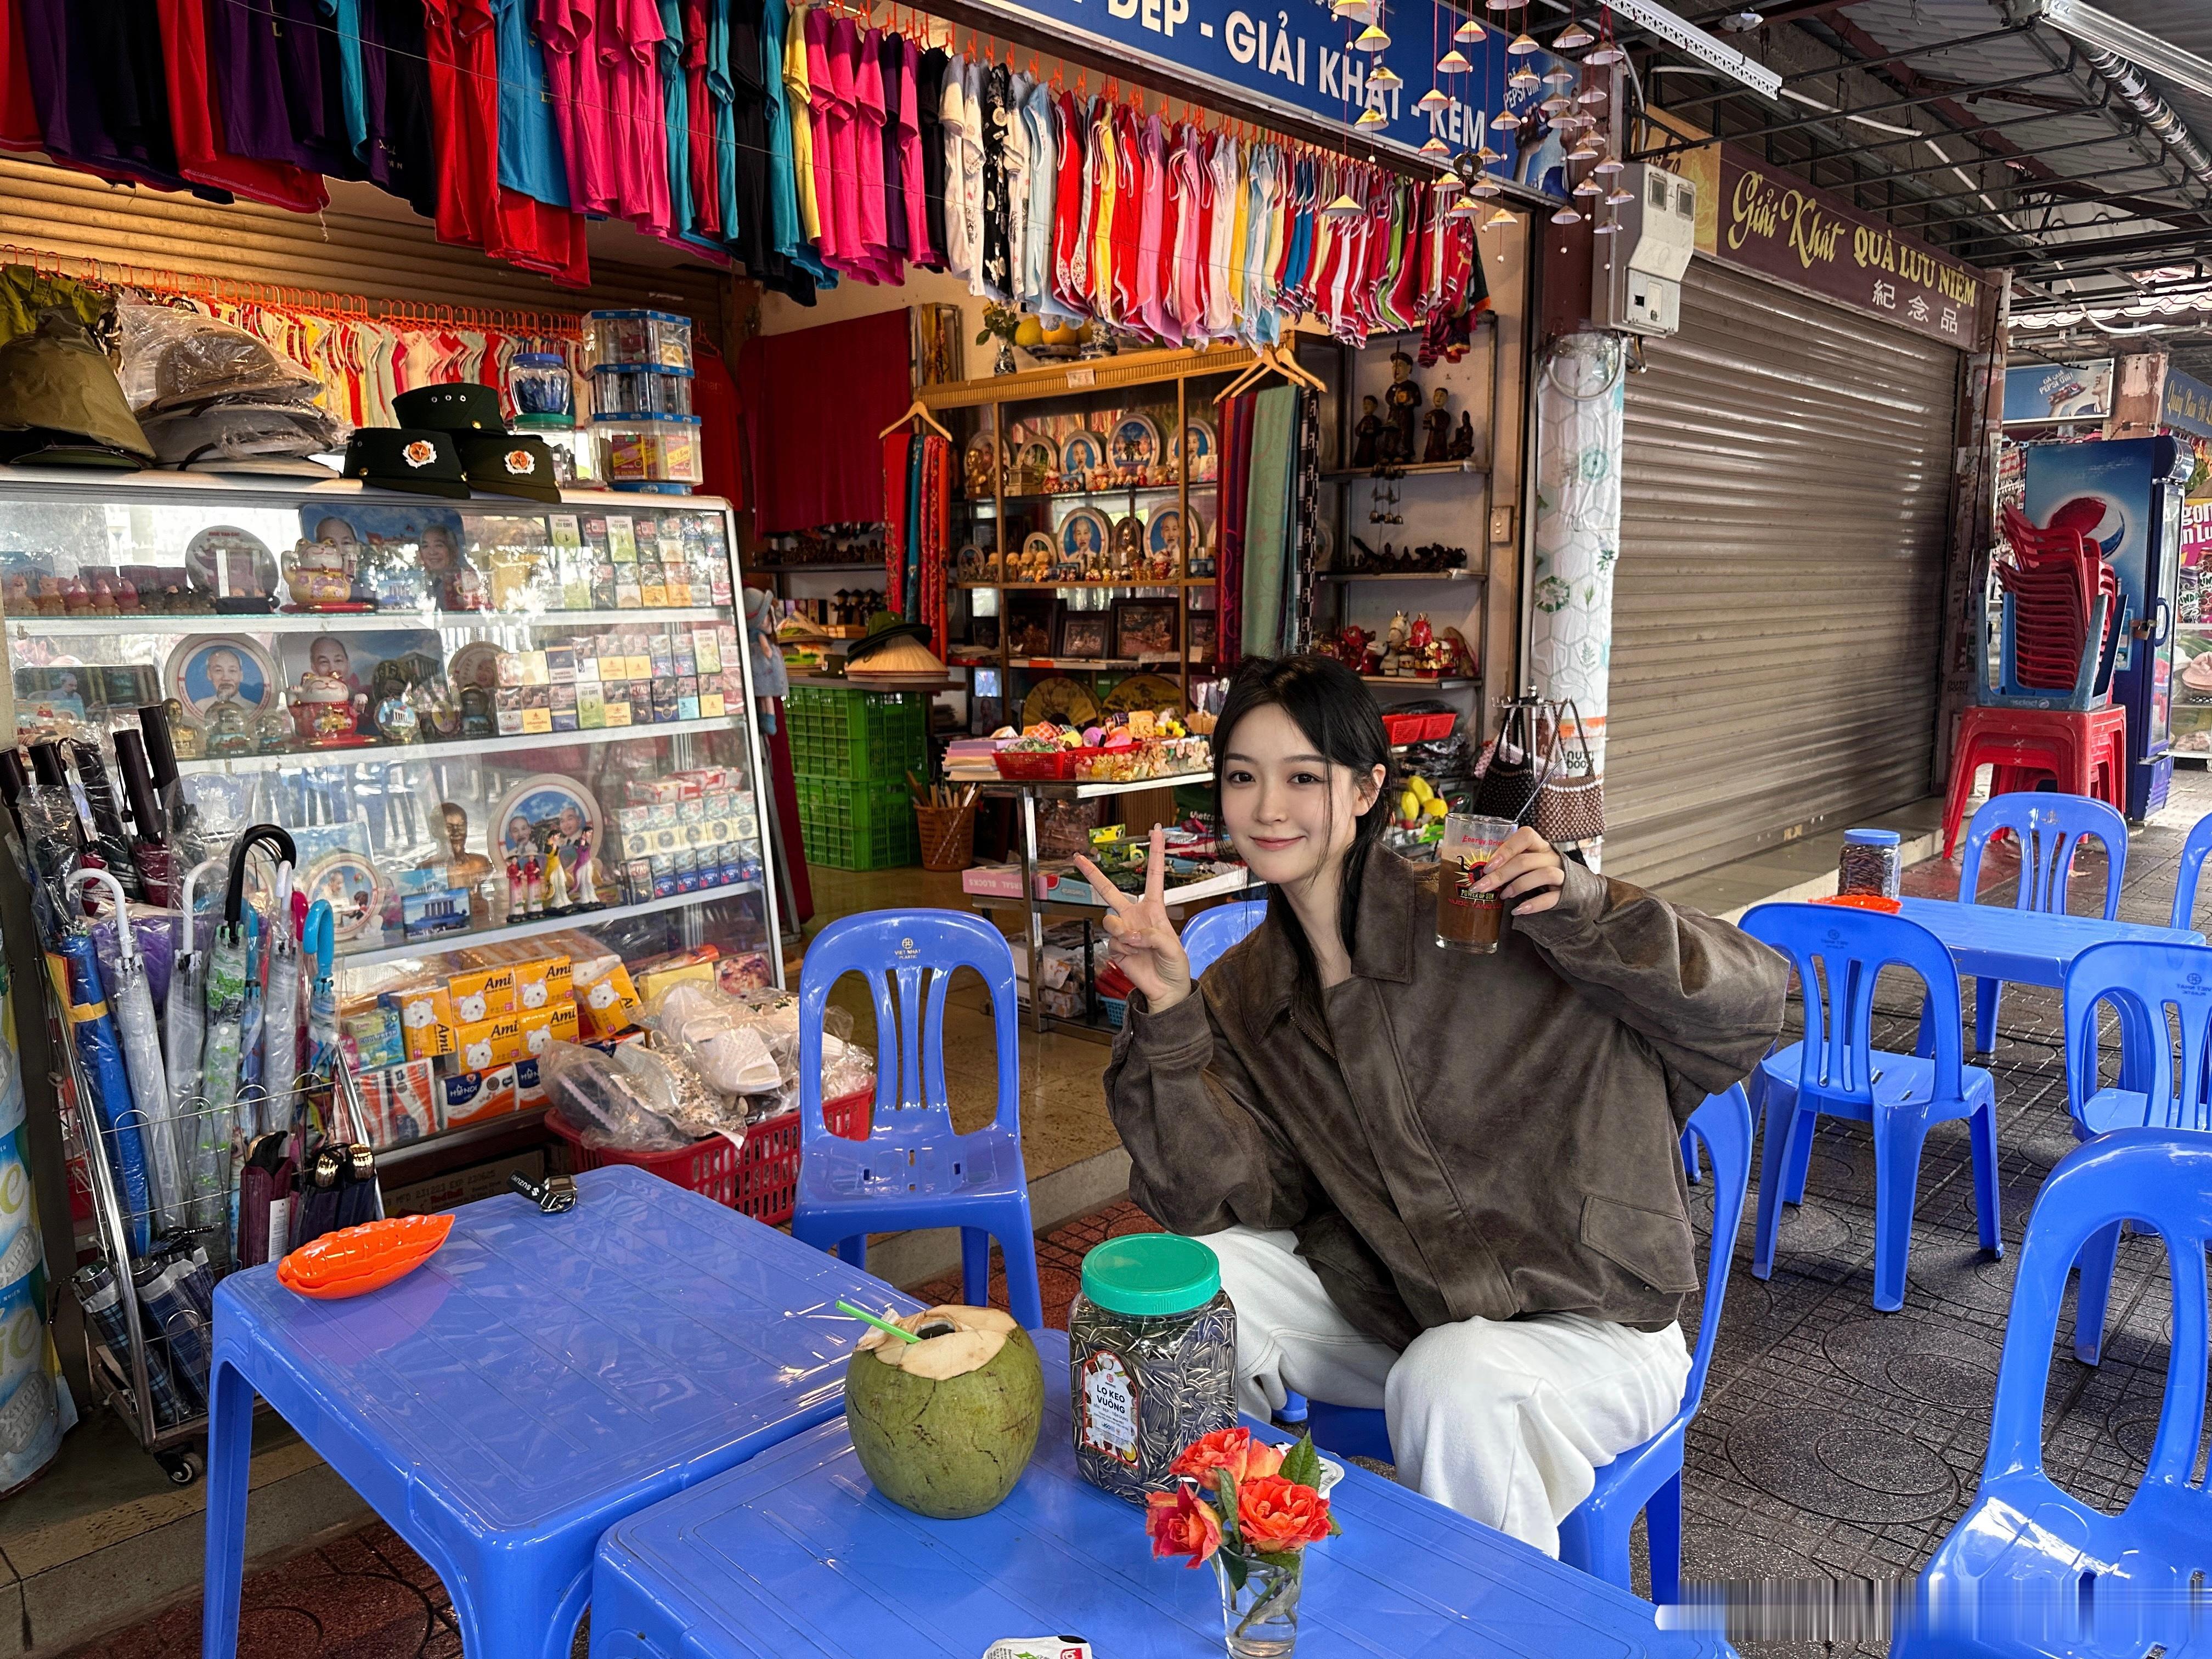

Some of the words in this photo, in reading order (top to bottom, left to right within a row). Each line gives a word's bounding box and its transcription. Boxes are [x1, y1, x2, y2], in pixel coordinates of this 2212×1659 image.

[1224, 10, 1305, 86] GIẢI
[1319, 46, 1403, 120] KHÁT
[1728, 171, 1779, 249] Giải
[1781, 189, 1846, 268] Khát
[1854, 226, 1895, 272] QUÀ
[1899, 246, 1936, 289] LƯU
[1938, 264, 1976, 308] NIỆM
[1872, 279, 1957, 335] 紀念品
[2039, 380, 2059, 395] PEPSI
[969, 879, 997, 888] BLOCKS
[546, 962, 571, 979] Ami
[484, 973, 512, 991] Ami
[550, 1007, 576, 1024] Ami
[491, 1019, 519, 1038] Ami
[438, 1023, 452, 1053] Ami
[511, 1174, 532, 1191] SUZUKI
[1097, 1395, 1125, 1414] VUÔNG
[1109, 1390, 1125, 1403] KEO
